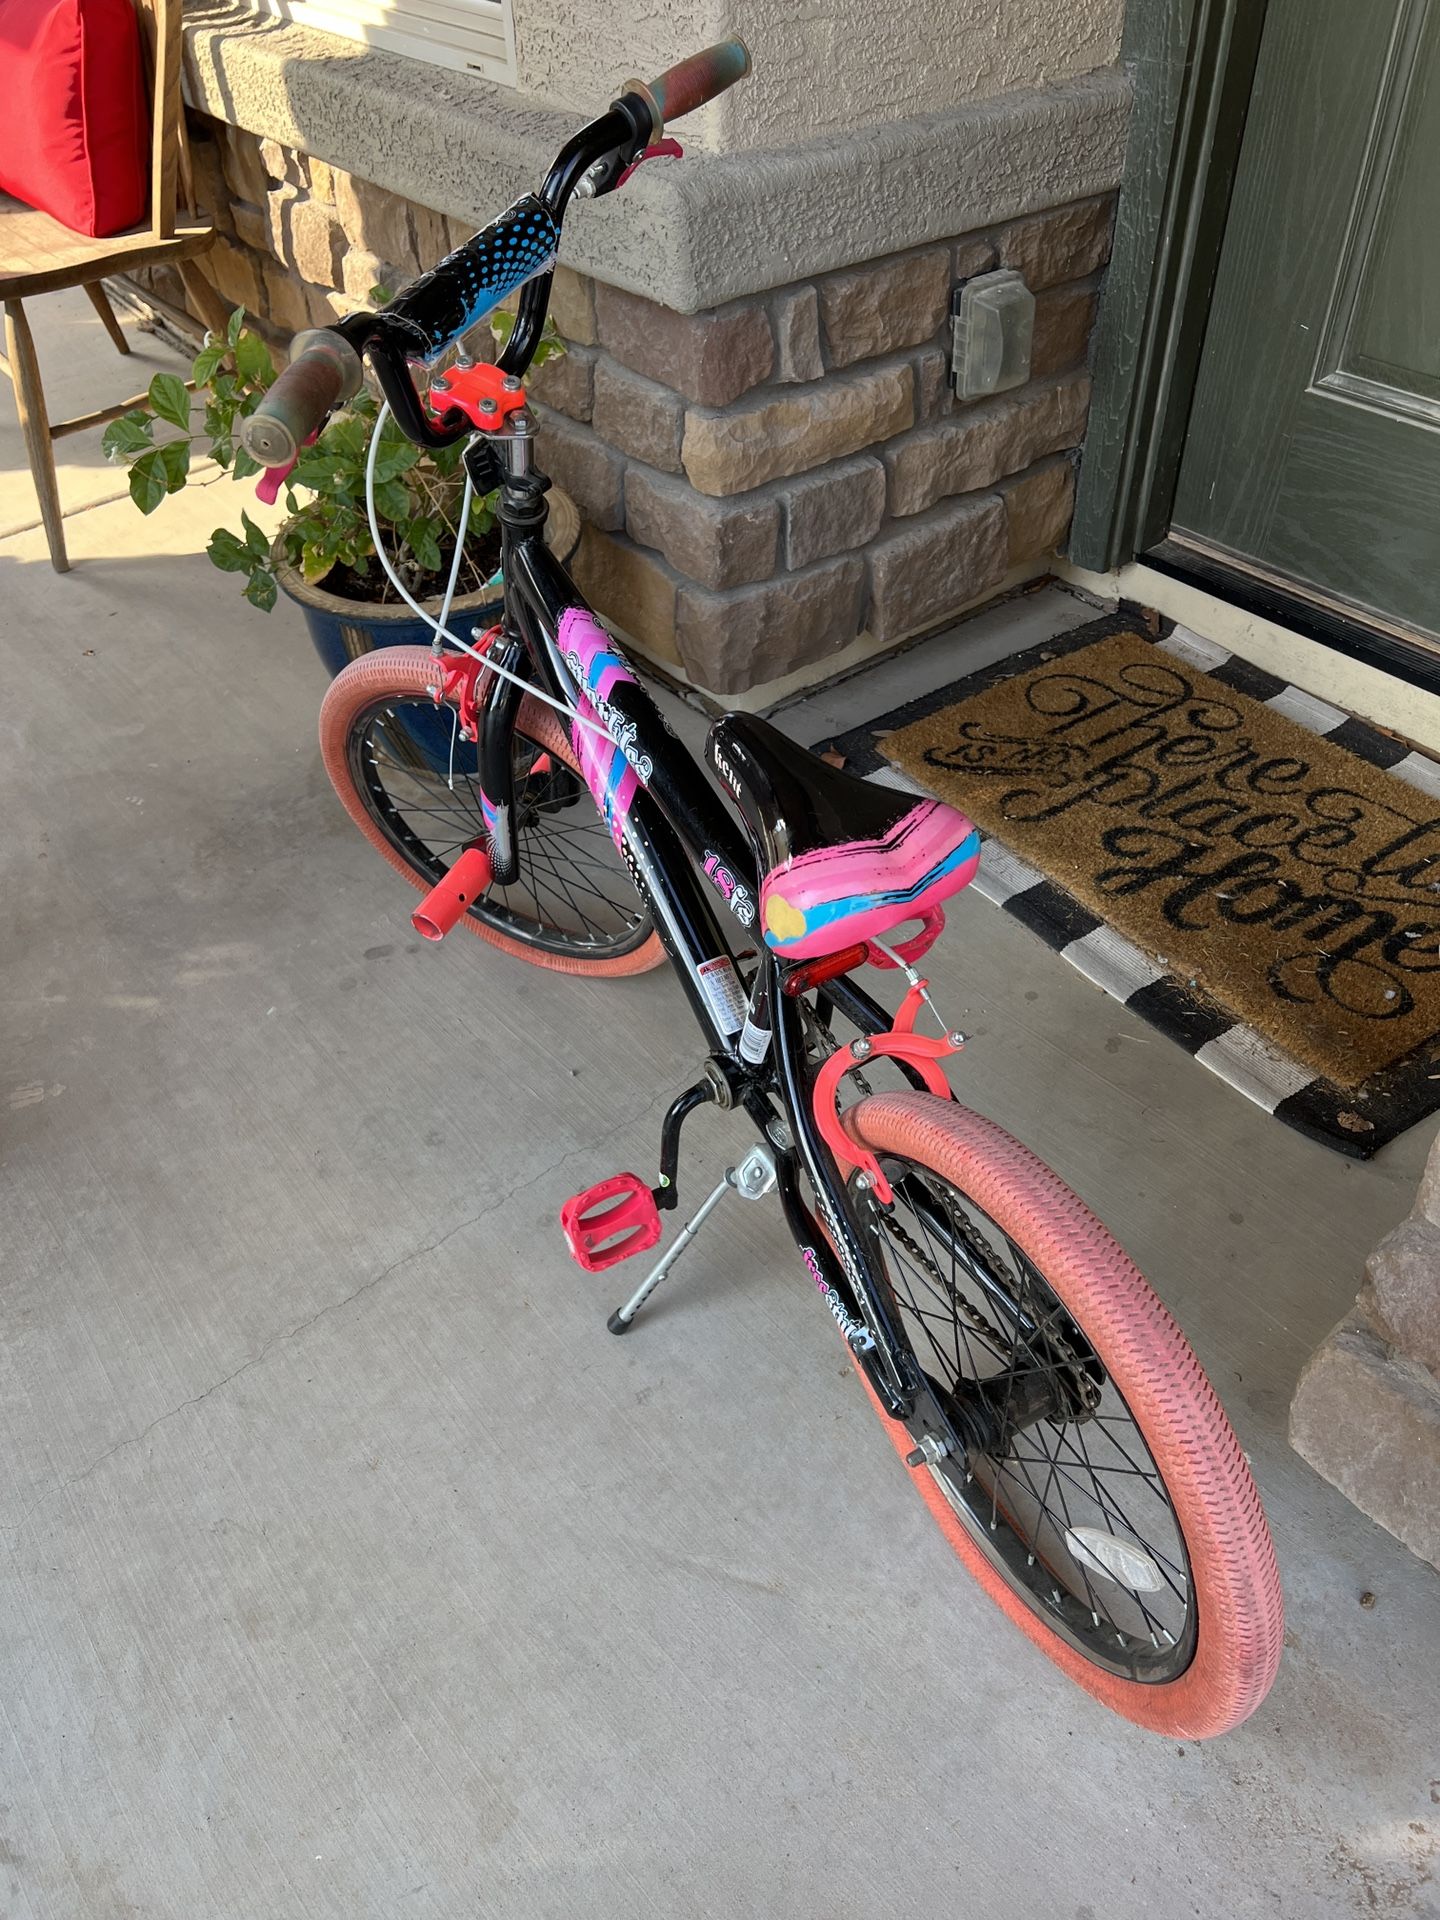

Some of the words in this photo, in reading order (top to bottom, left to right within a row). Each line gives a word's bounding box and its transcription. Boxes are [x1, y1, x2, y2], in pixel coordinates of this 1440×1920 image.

[1026, 663, 1311, 796] There
[1001, 763, 1357, 866] Place
[1094, 826, 1440, 1019] Home
